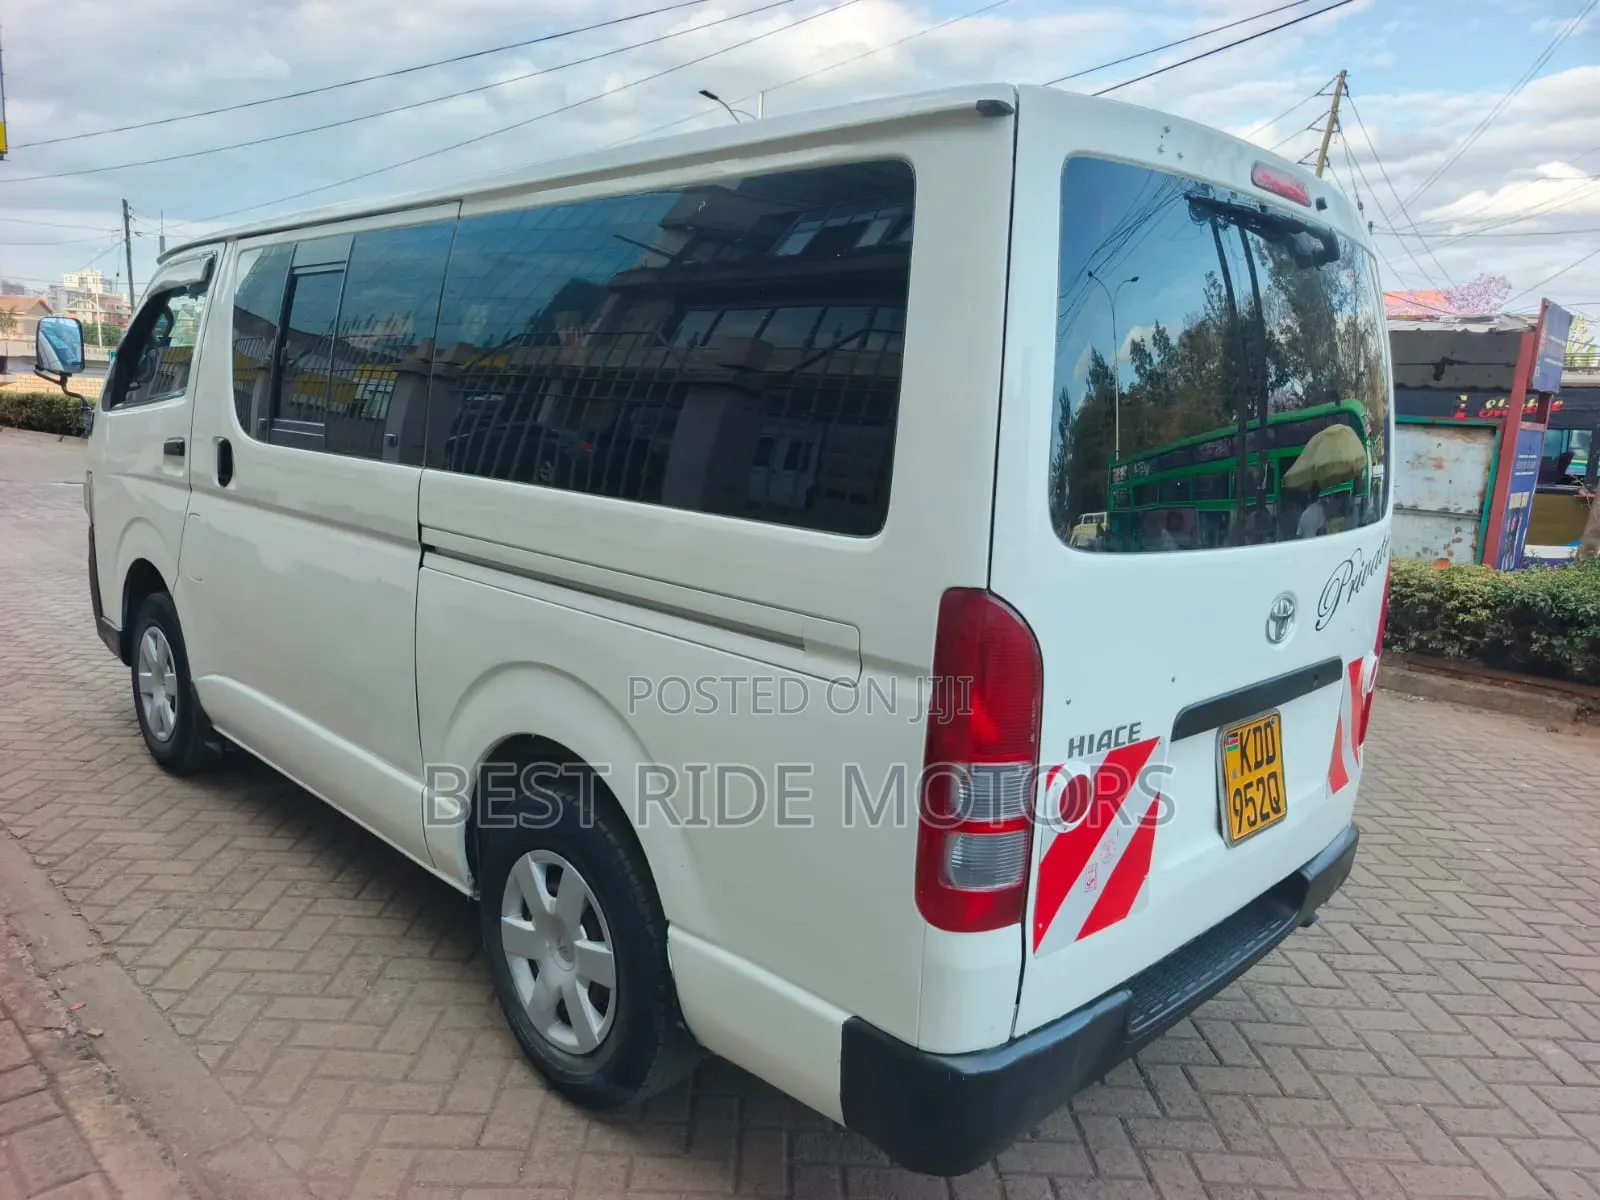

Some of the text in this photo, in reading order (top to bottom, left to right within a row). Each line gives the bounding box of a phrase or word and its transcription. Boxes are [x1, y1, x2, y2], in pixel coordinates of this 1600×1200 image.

[1067, 722, 1142, 758] HIACE
[1240, 721, 1276, 776] KDD
[1232, 771, 1281, 834] 952Q
